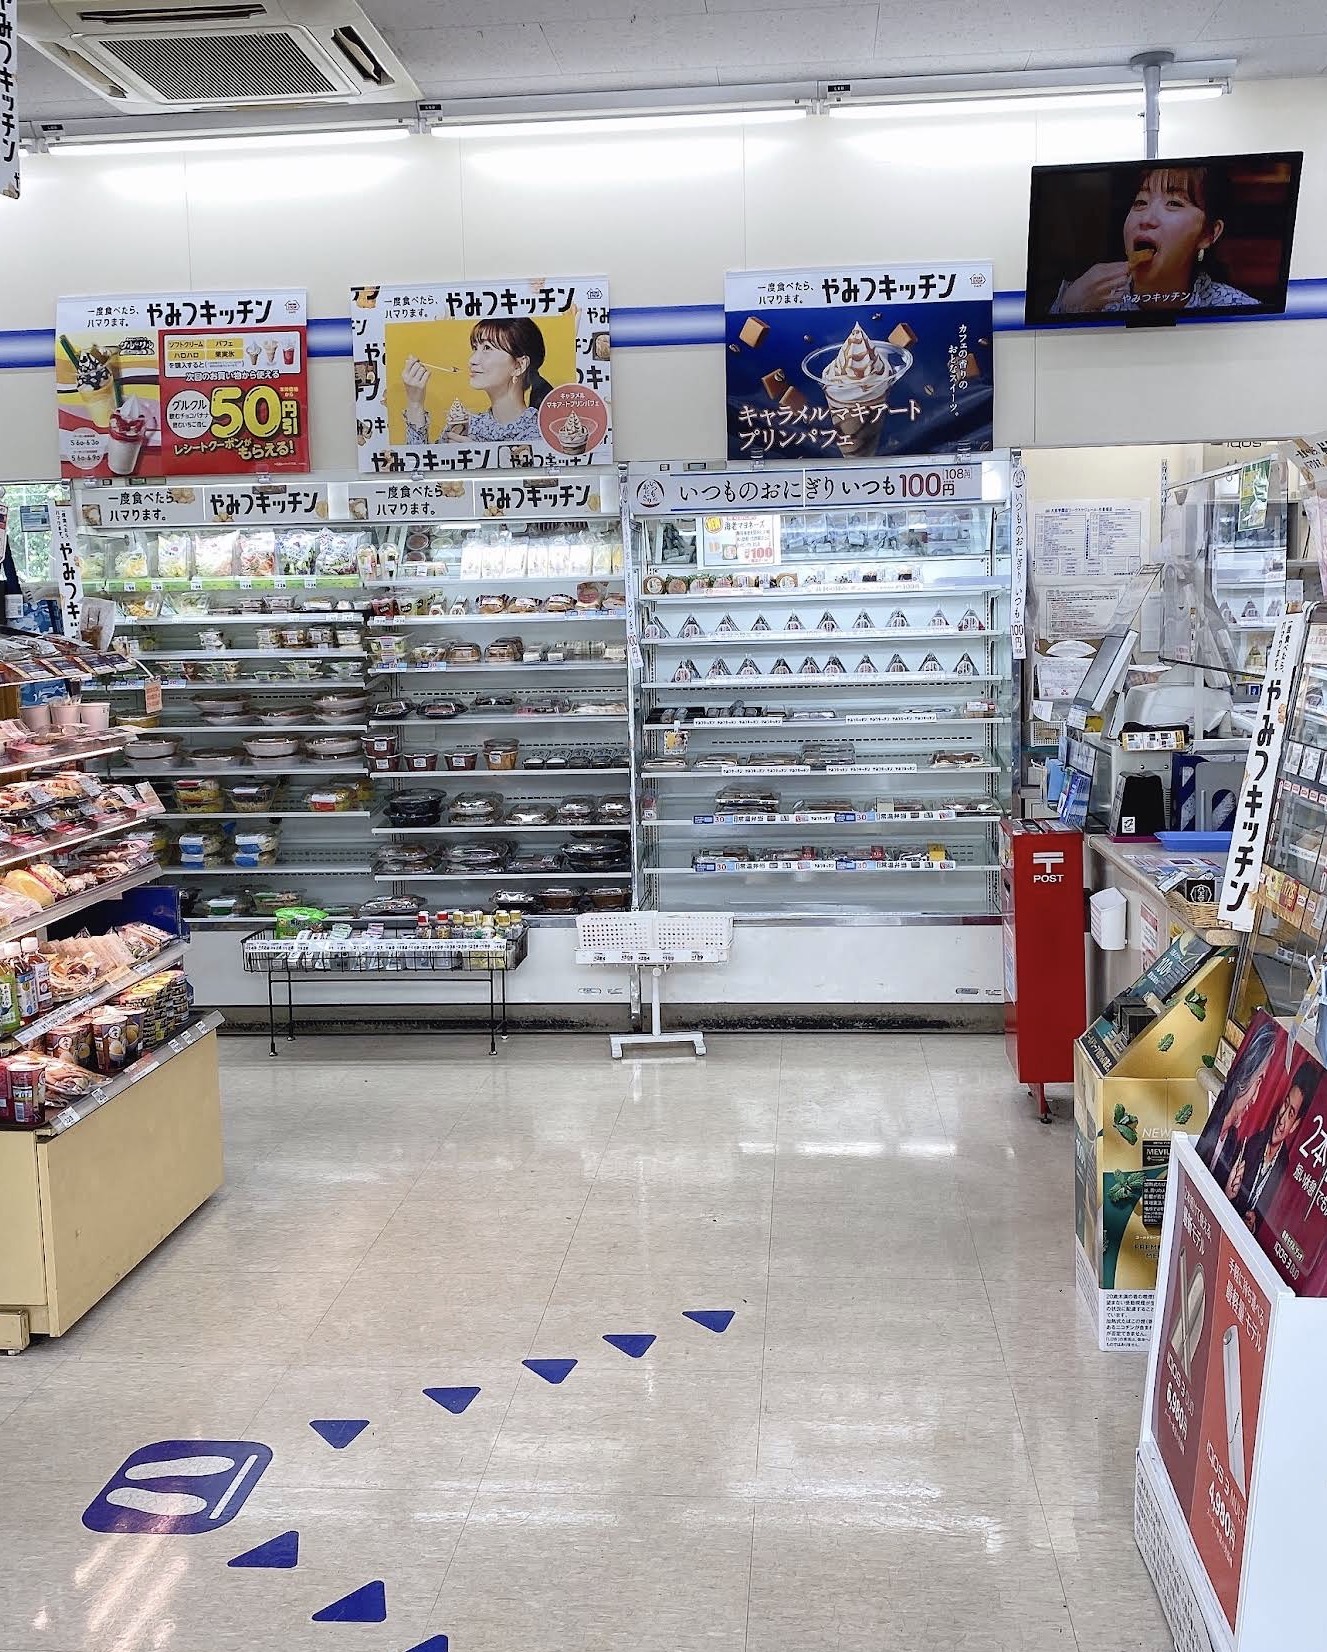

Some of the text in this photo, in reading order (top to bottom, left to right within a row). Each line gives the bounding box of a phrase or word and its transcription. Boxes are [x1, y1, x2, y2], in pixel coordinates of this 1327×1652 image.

[758, 280, 814, 292] 一度食べたら、
[822, 274, 956, 304] やみつキッチン
[384, 294, 438, 306] 一度食べたら、
[446, 288, 576, 317] やみつキッチン
[758, 294, 804, 304] ハマります。
[1121, 291, 1192, 304] やみつキッチン
[87, 305, 140, 316] 一度食べたら、
[147, 300, 273, 328] やみつキッチン
[385, 308, 428, 319] ハマります。
[87, 317, 130, 328] ハマります。
[958, 323, 968, 390] カフェの香りの
[185, 370, 280, 381] 次回のお買い物から使える
[948, 344, 960, 417] おとなスイーツ。
[560, 392, 585, 400] キャラメル
[210, 385, 281, 438] 50
[546, 401, 600, 409] マキアートプリンパフェ
[738, 399, 922, 428] キャラメルマキアート
[174, 438, 252, 456] レシートクーポンが
[739, 427, 855, 451] プリンパフェ
[680, 477, 835, 502] いつものおにぎり
[842, 475, 896, 497] いつも
[210, 492, 318, 516] やみつキッチン
[481, 484, 591, 510] やみつキッチン
[110, 508, 166, 522] ハマります。
[377, 501, 436, 516] ハマります。
[1227, 679, 1282, 912] やみつキッチン
[1033, 874, 1065, 883] POST
